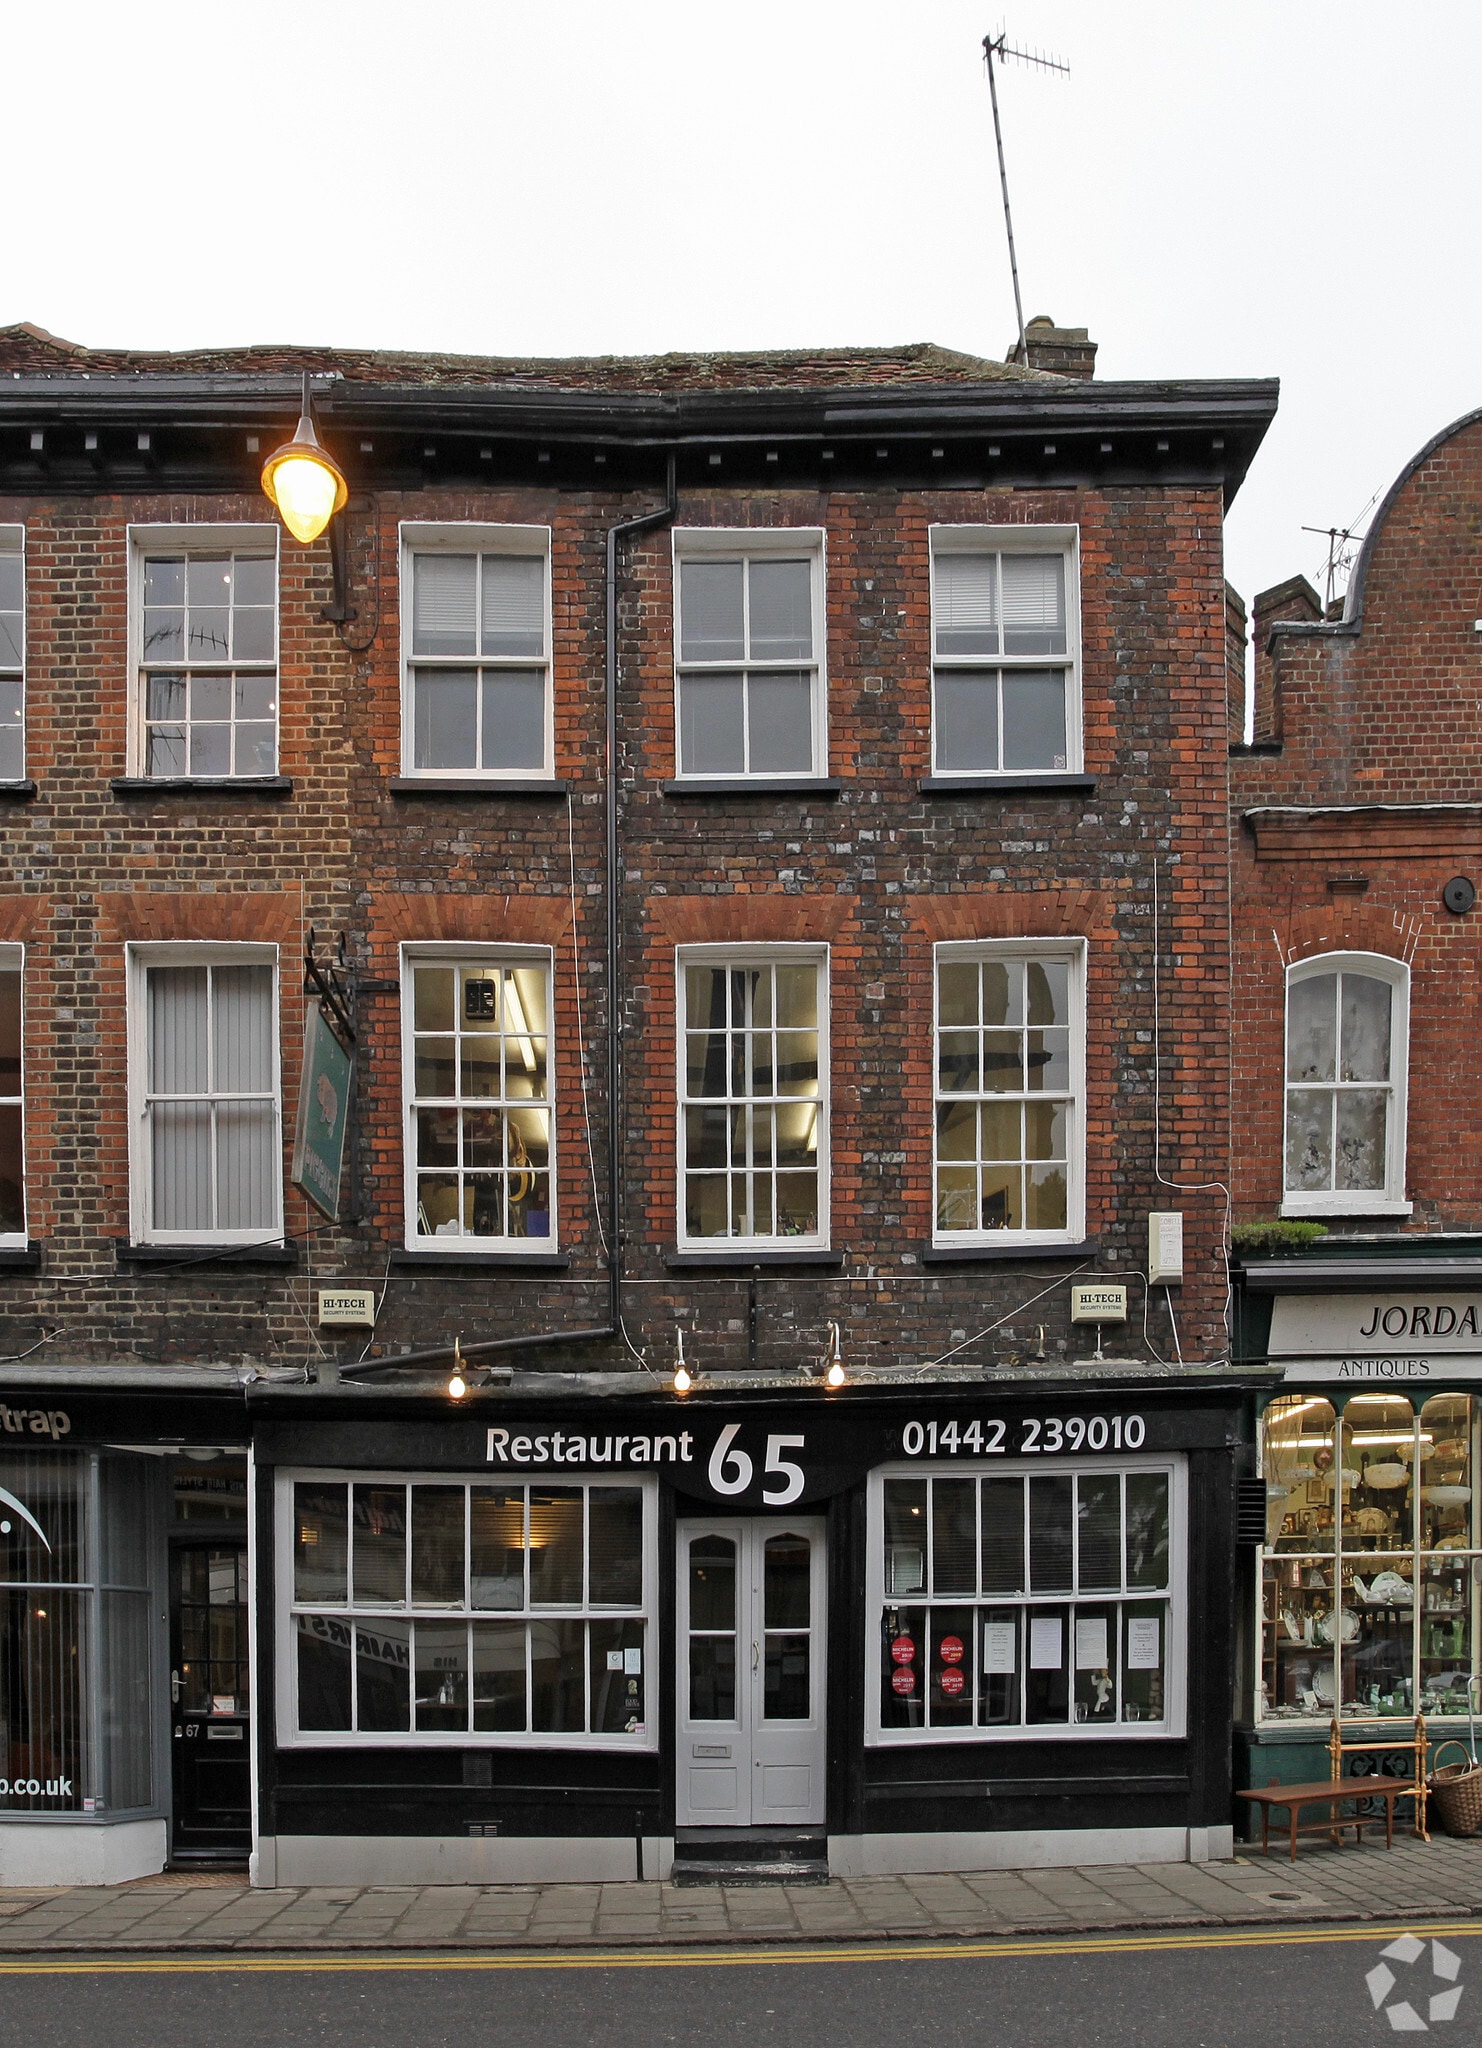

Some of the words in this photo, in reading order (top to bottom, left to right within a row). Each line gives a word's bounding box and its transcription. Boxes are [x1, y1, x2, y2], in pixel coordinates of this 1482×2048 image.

[1360, 1305, 1482, 1338] JORDA
[1338, 1359, 1430, 1378] ANTIQUES
[0, 1403, 72, 1440] trap
[902, 1420, 1006, 1455] 01442
[1020, 1414, 1146, 1453] 239010
[485, 1427, 694, 1463] Restaurant
[707, 1423, 806, 1506] 65
[186, 1724, 200, 1738] 67
